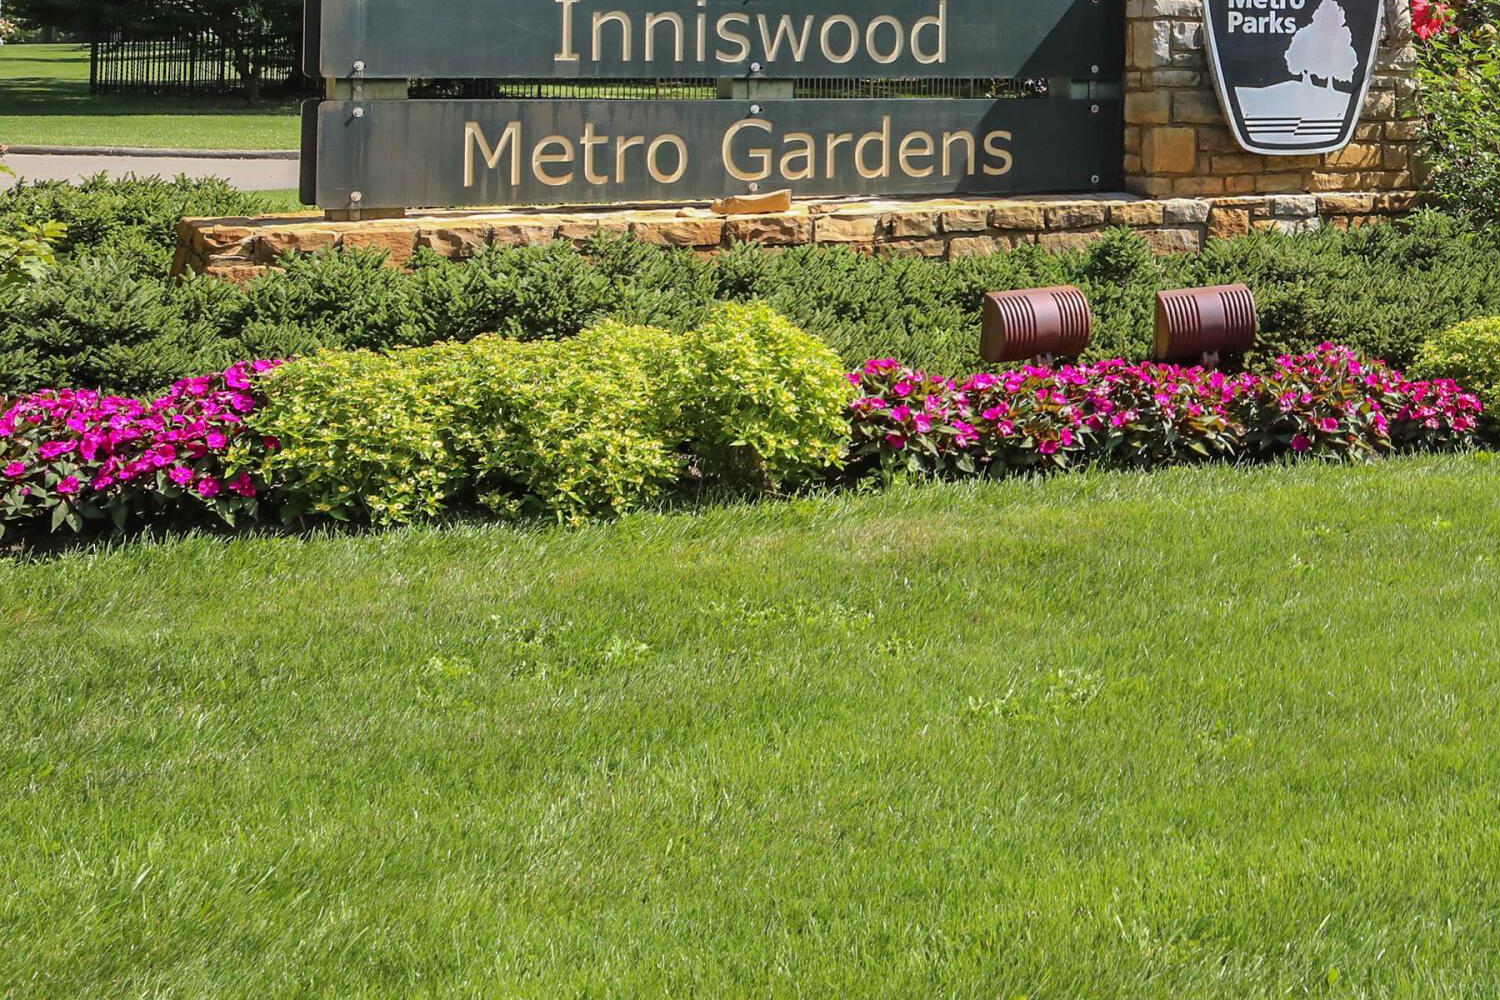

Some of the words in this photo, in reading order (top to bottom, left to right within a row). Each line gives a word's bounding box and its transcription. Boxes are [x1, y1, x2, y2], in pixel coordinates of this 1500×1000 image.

[1228, 11, 1297, 34] Parks
[463, 120, 689, 188] Metro
[722, 116, 1014, 183] Gardens
